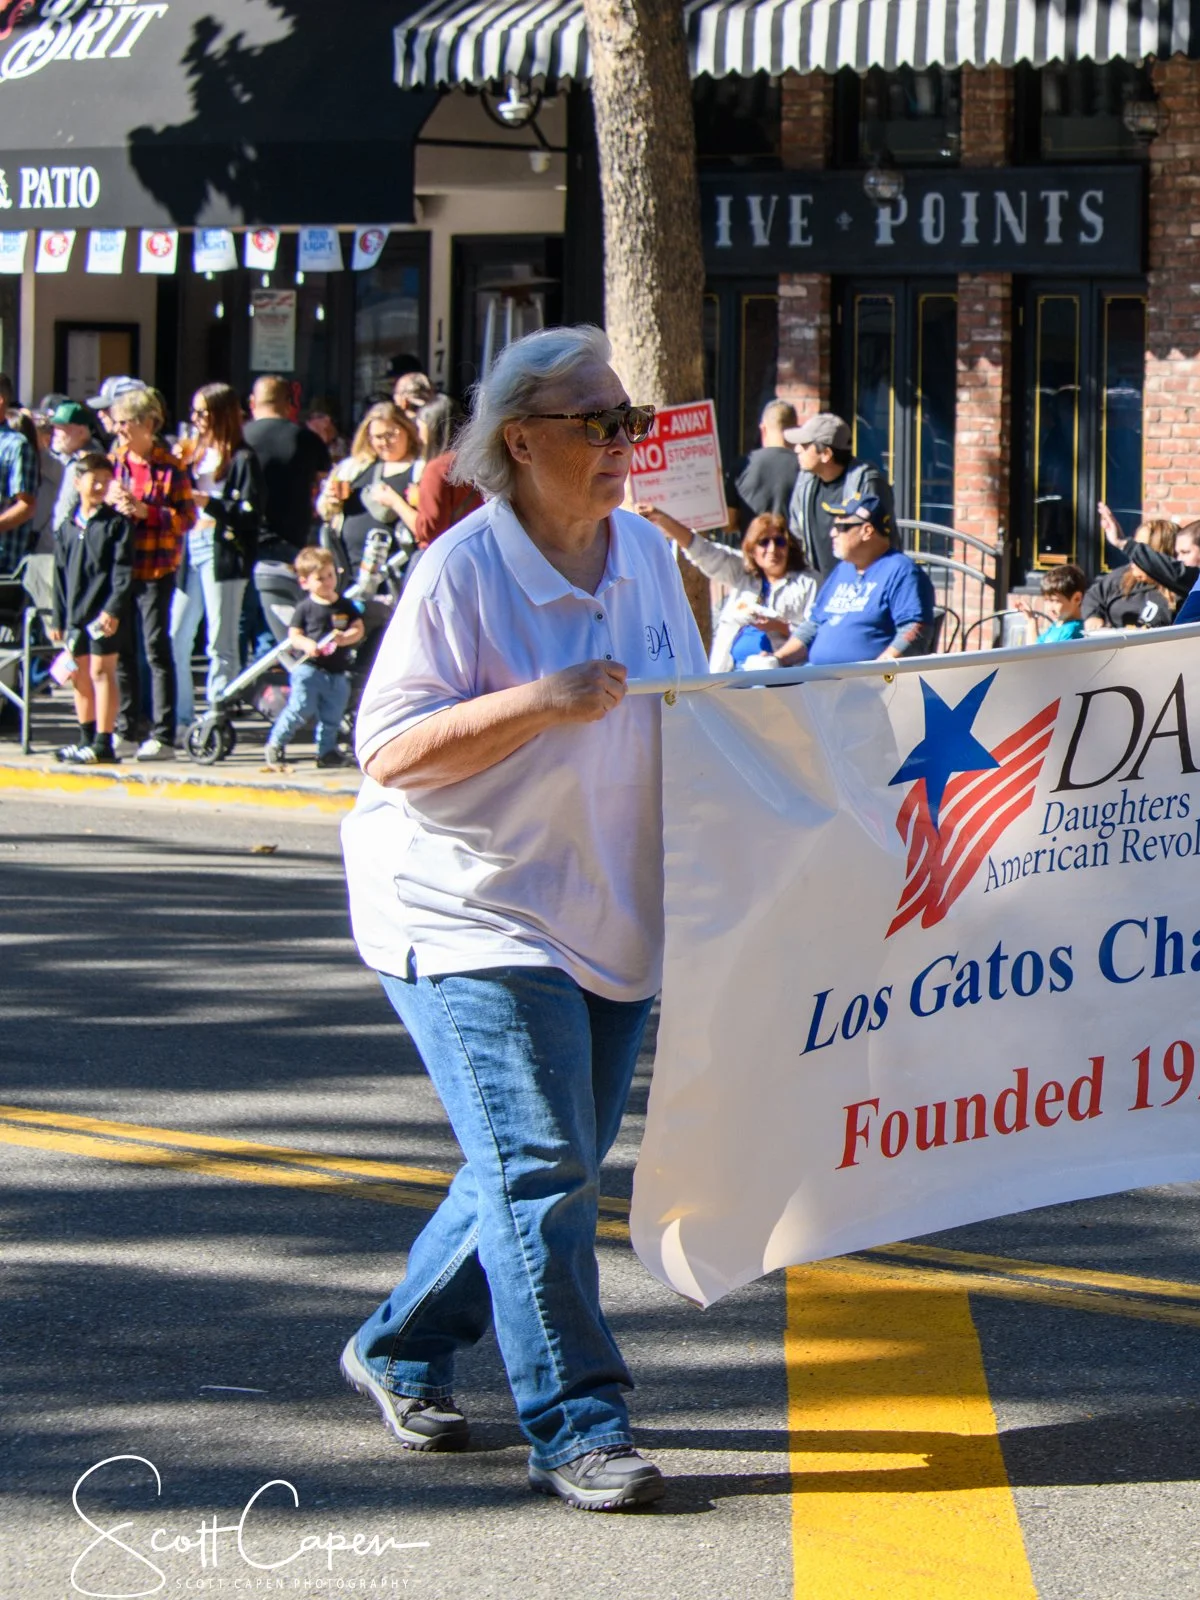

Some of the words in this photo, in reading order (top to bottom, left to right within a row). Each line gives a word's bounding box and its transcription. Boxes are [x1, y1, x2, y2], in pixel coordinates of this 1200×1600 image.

[19, 166, 100, 208] PATIO
[715, 194, 813, 247] IVE
[875, 190, 1104, 245] POINTS
[631, 444, 664, 471] NO
[668, 442, 714, 463] STOPPING
[645, 620, 675, 661] DA
[1039, 788, 1190, 839] Daughters
[984, 836, 1108, 893] American
[800, 983, 894, 1056] Los
[909, 940, 1074, 1017] Gatos
[835, 1055, 1106, 1170] Founded
